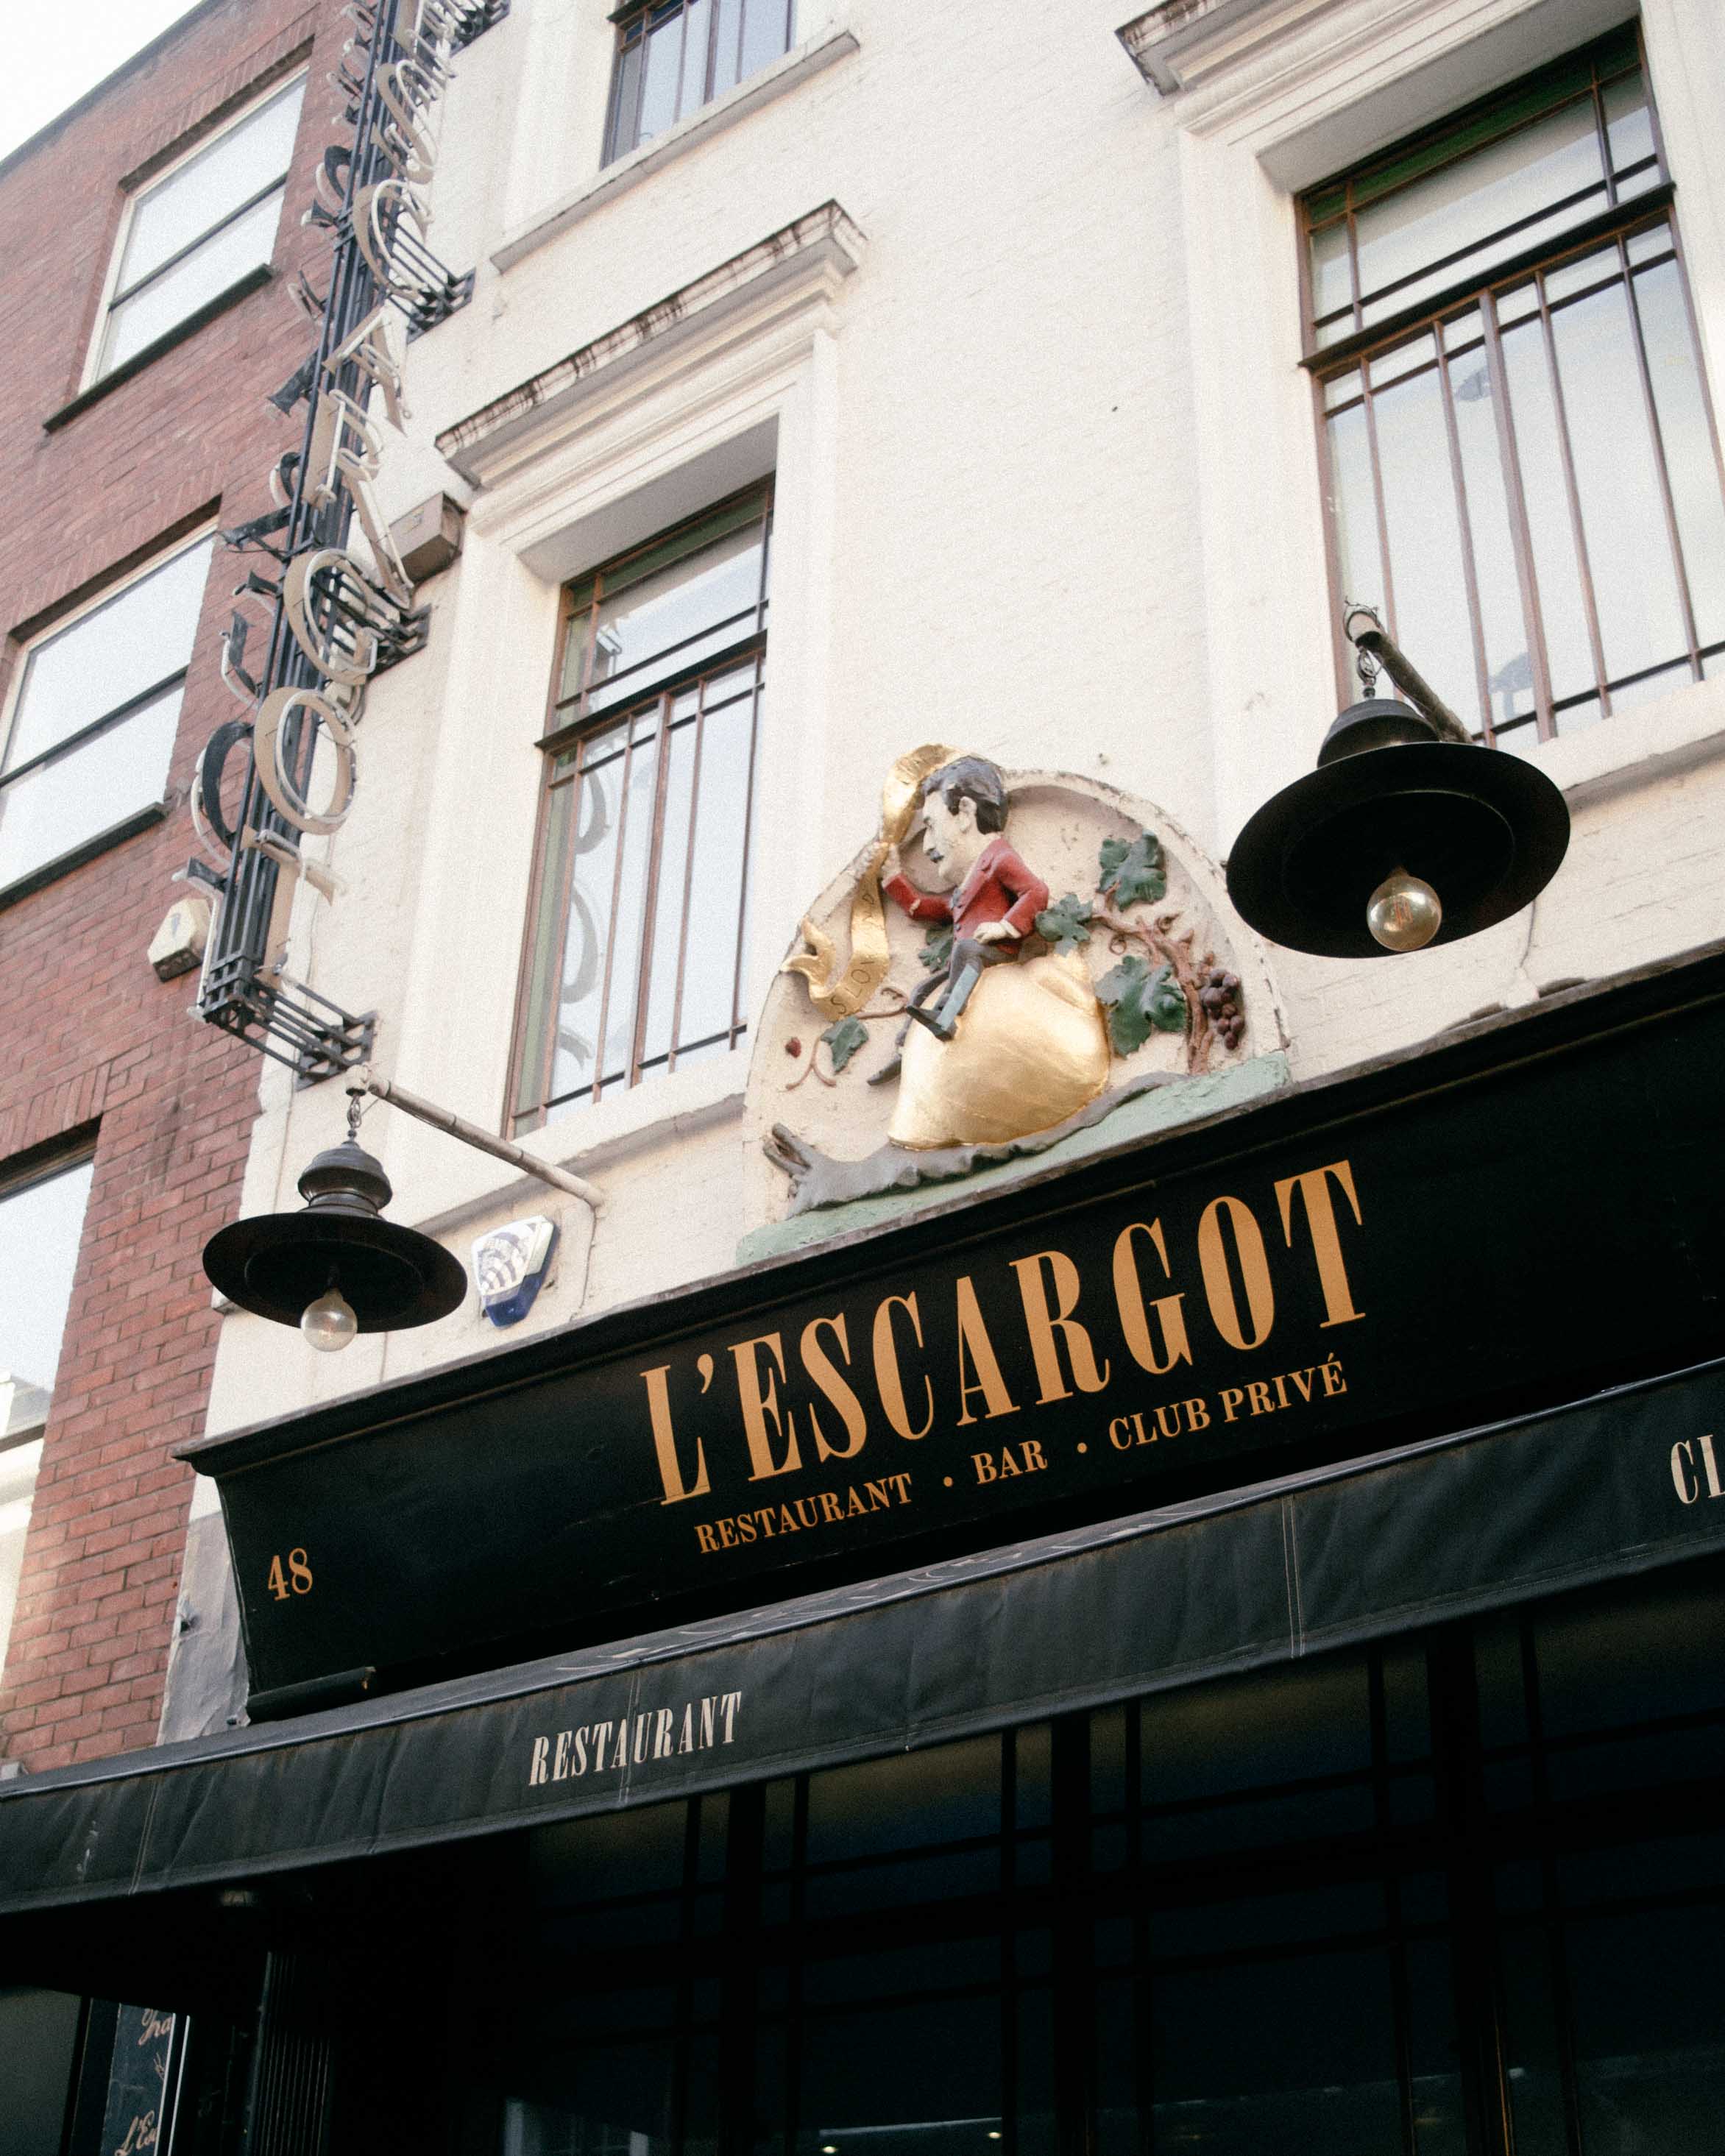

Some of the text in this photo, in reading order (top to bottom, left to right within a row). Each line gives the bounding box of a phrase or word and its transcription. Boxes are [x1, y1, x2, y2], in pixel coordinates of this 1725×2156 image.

[640, 1160, 1366, 1506] L'ESCARGOT
[695, 1352, 1347, 1553] RESTAURANT BAR CLUB PRIVÉ
[267, 1547, 314, 1601] 48
[528, 1690, 743, 1787] RESTAURANT
